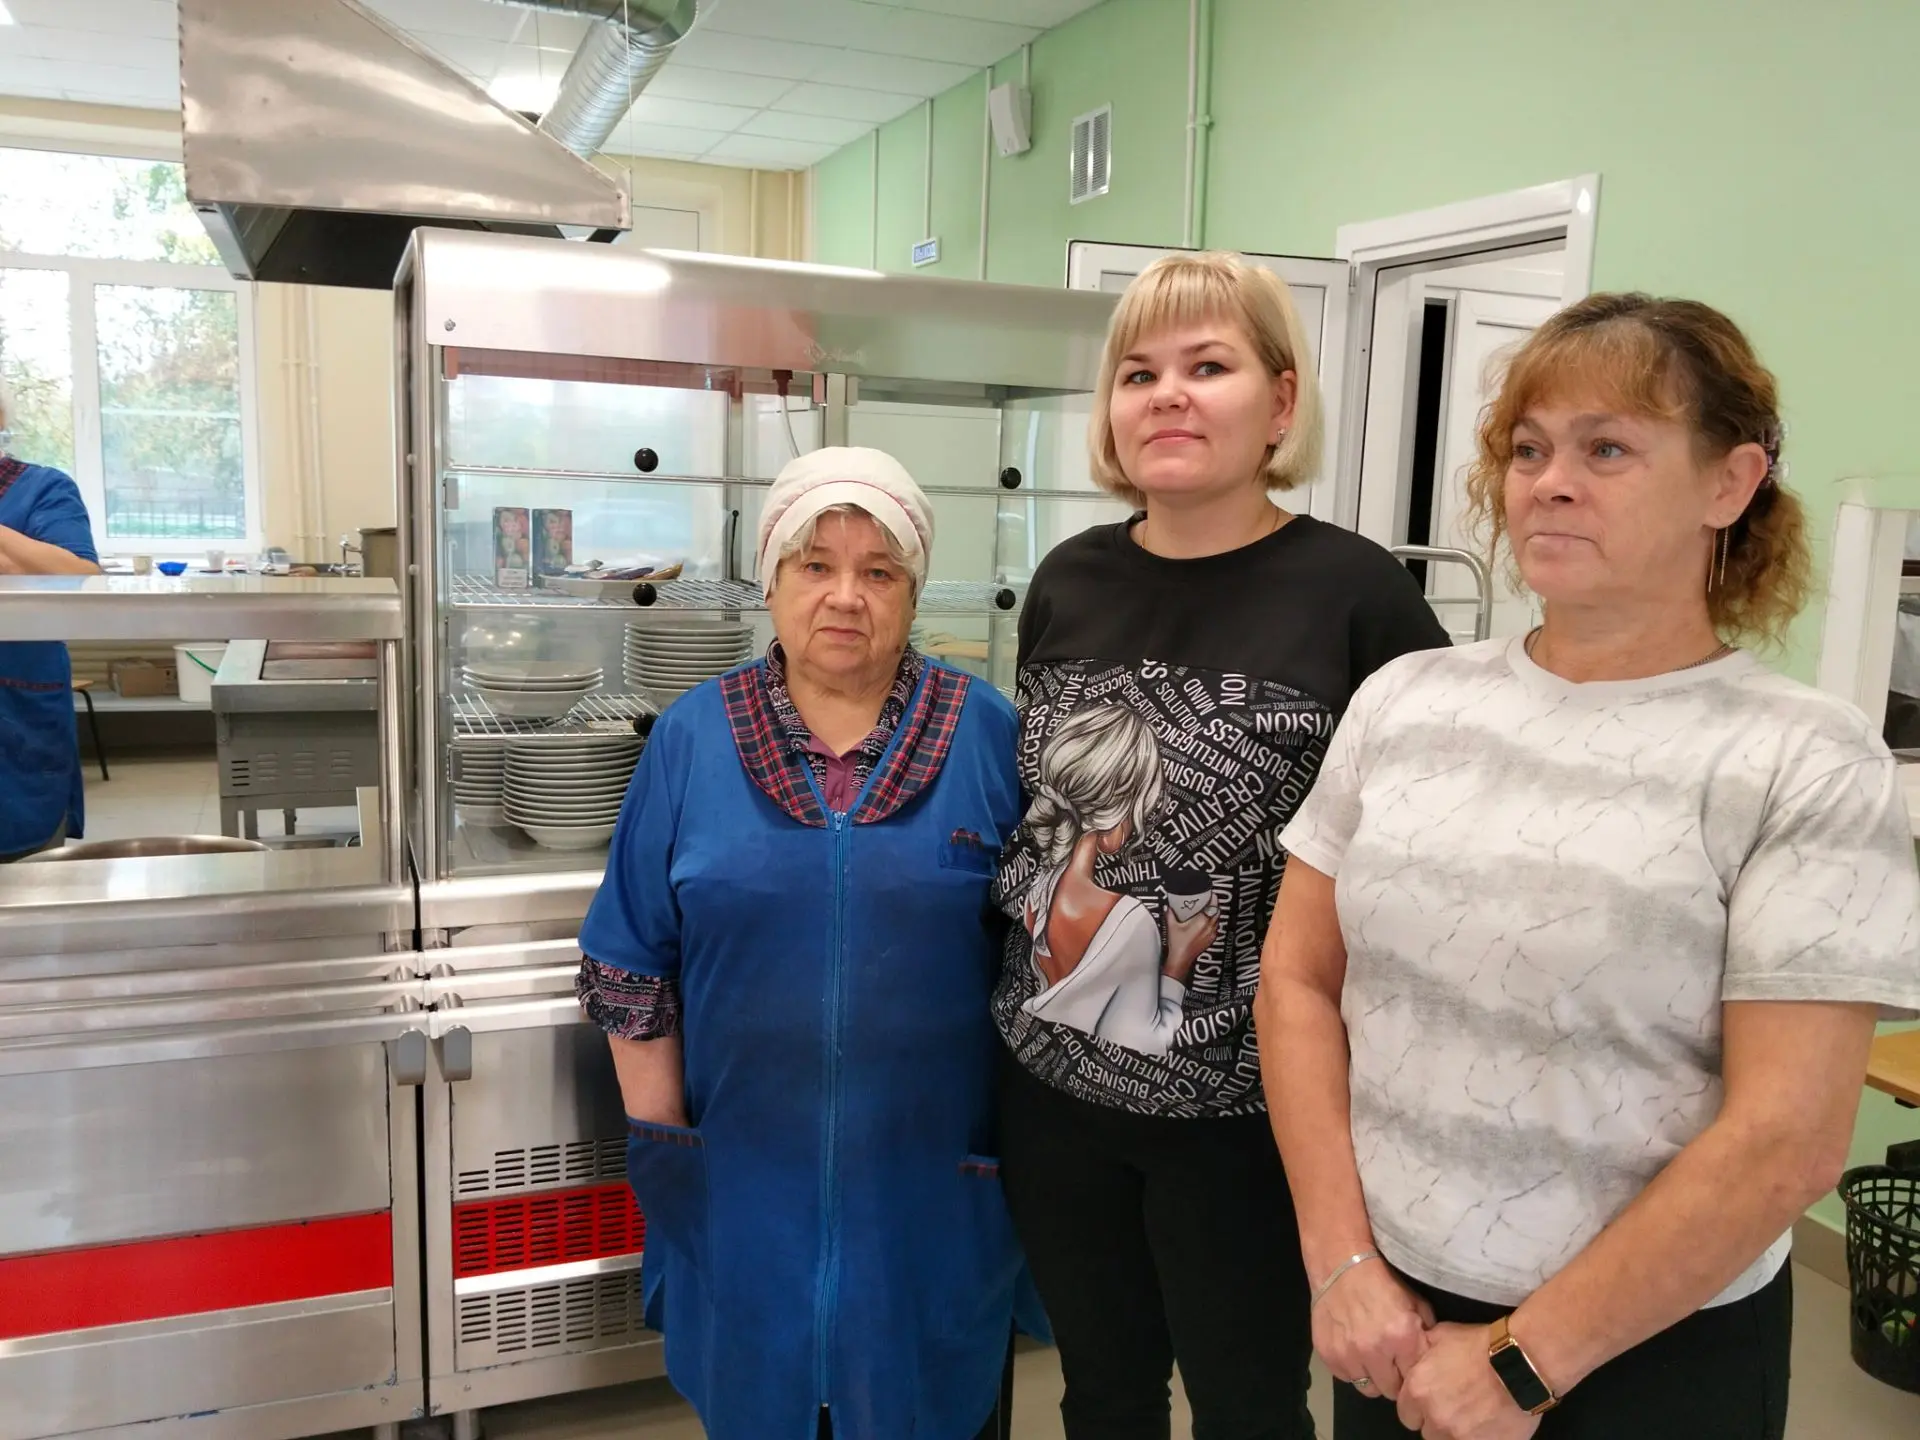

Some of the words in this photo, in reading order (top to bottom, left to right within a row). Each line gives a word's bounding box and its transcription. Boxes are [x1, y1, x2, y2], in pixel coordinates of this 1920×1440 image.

[1045, 673, 1086, 736] CREATIVE
[1084, 671, 1133, 700] SUCCESS
[1122, 682, 1165, 723] CREATIVE
[1183, 678, 1217, 716] MIND
[1156, 682, 1204, 737] SOLUTION
[1256, 712, 1335, 740] VISION
[1203, 718, 1293, 781] BUSINESS
[1163, 771, 1264, 845] CREATIVE
[1235, 862, 1263, 988] INNOVATIVE
[1052, 1022, 1085, 1060] IDEA
[1203, 1045, 1233, 1061] MIND
[1078, 1056, 1150, 1099] BUSINESS
